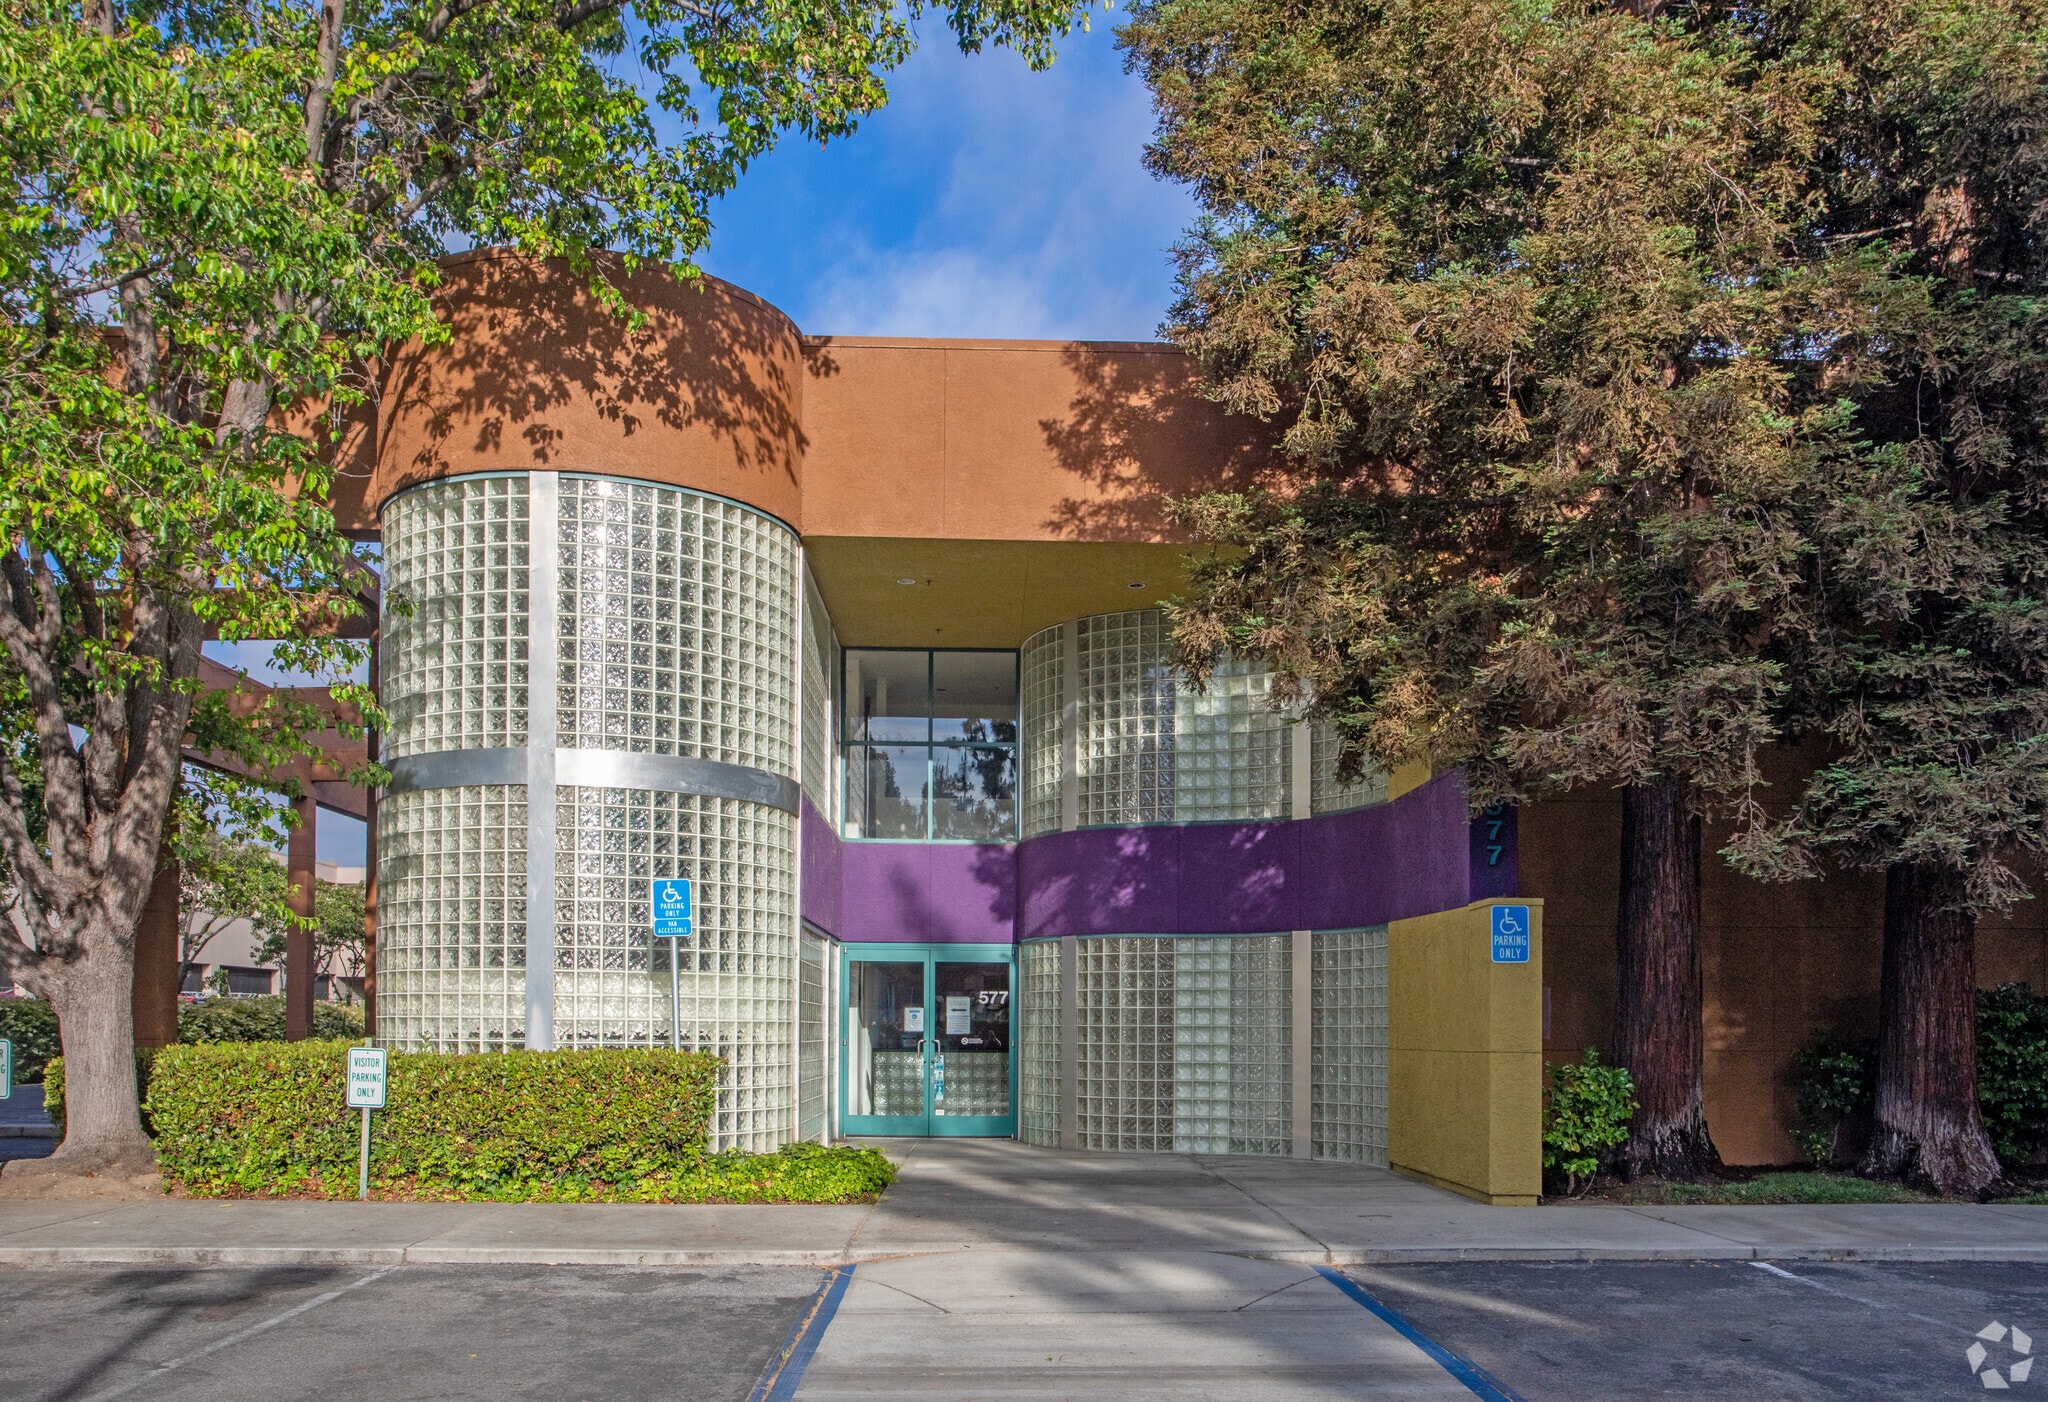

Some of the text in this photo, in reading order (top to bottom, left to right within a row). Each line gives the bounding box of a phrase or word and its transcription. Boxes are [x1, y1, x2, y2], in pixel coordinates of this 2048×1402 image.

[660, 902, 685, 910] PARKING
[1494, 935, 1527, 946] PARKING
[1500, 947, 1521, 959] ONLY
[978, 990, 1009, 1005] 577
[354, 1057, 380, 1068] VISITOR
[351, 1072, 382, 1083] PARKING
[356, 1087, 376, 1098] ONLY
